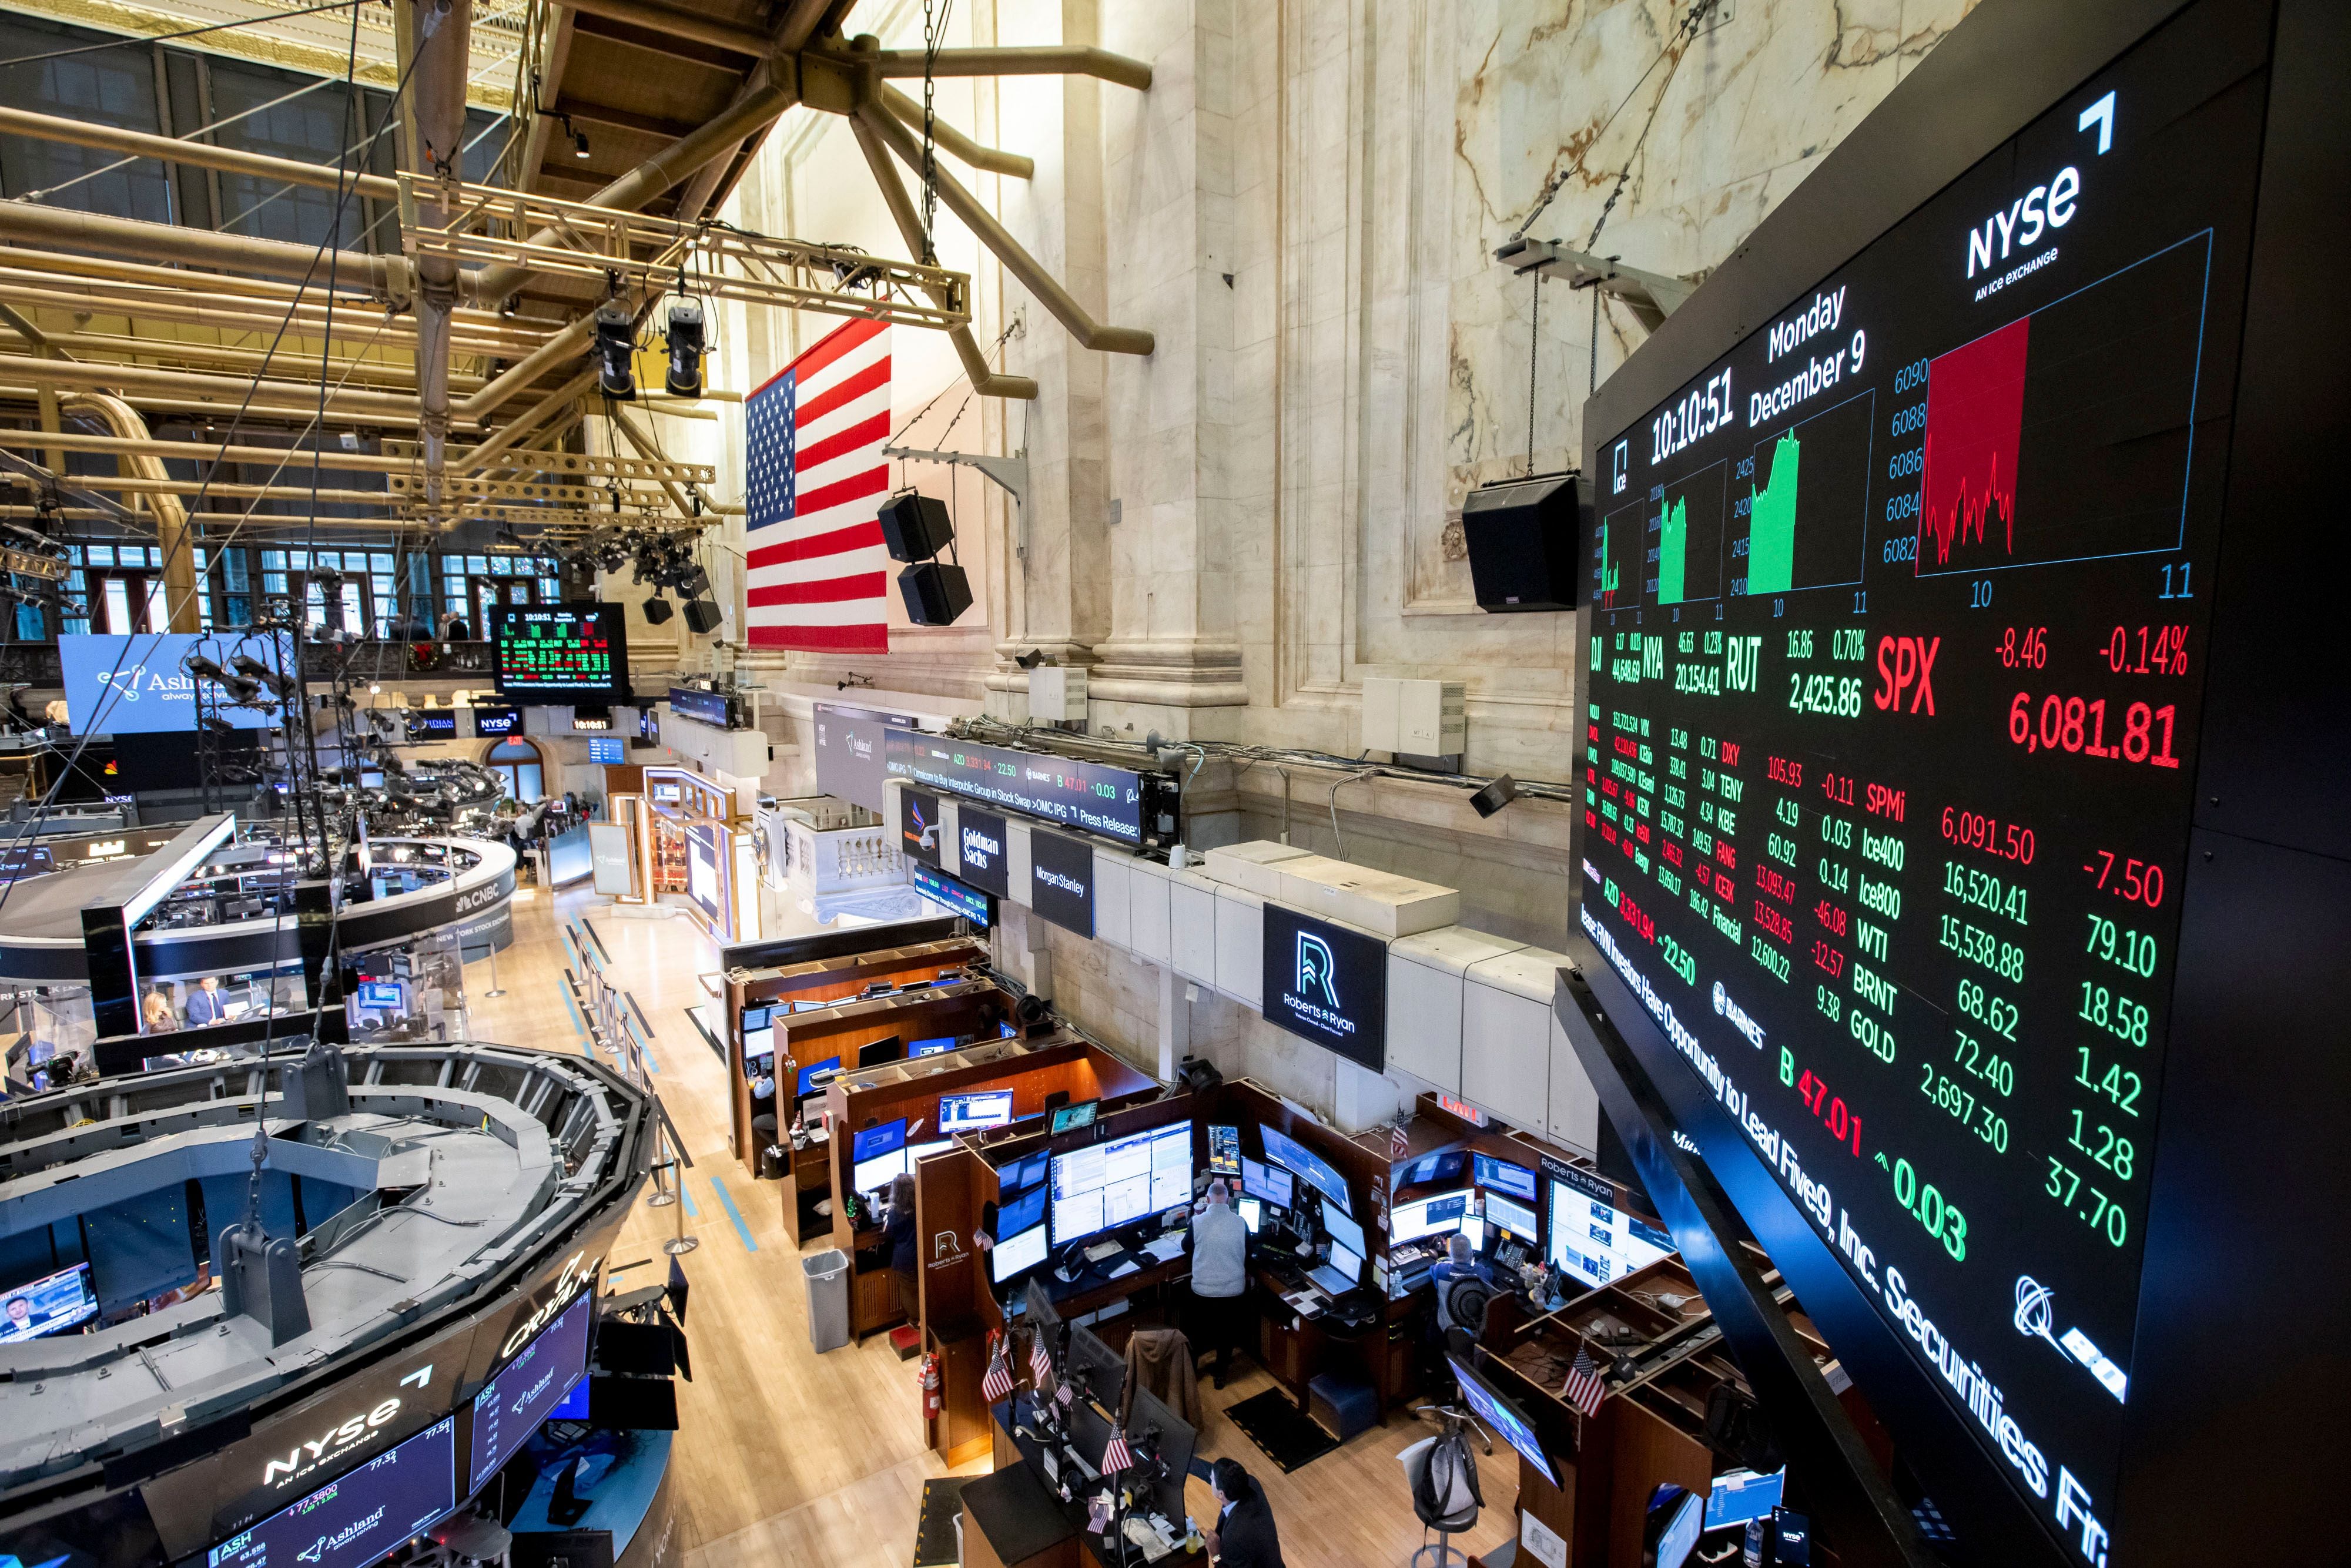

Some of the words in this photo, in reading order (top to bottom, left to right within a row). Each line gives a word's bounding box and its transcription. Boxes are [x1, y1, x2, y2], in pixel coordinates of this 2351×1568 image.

[1975, 289, 1988, 302] AN
[1769, 286, 1846, 363] Monday
[1750, 347, 1846, 427] December
[1851, 330, 1866, 374] 9
[1895, 357, 1928, 394] 6090
[1652, 367, 1733, 465] 10:10:51
[1892, 403, 1926, 437] 6088
[1736, 456, 1754, 480] 2425
[1889, 447, 1923, 479] 6086
[1734, 497, 1751, 518] 2420
[1887, 491, 1920, 521] 6084
[1733, 537, 1750, 557] 2415
[1884, 536, 1917, 563] 6082
[1730, 577, 1747, 596] 2410
[1971, 581, 1992, 608] 10
[2159, 562, 2193, 599] 11
[1590, 636, 1602, 672] DJI
[1616, 633, 1625, 650] 6.17
[1643, 636, 1663, 680] NYA
[1679, 632, 1694, 654] 46.63
[1704, 631, 1722, 655] 0.23%
[1787, 630, 1813, 659] 16.86
[1833, 629, 1866, 661] 0.70%
[1995, 627, 2047, 669] -8.46
[2099, 625, 2189, 675] -0.14%
[1612, 658, 1640, 684] 44,648.69
[1675, 664, 1720, 696] 20,154.41
[1726, 636, 1761, 692] RUT
[1874, 635, 1940, 716] SPX
[1789, 673, 1862, 718] 2,425.86
[574, 721, 607, 729] 10:10:51
[1640, 718, 1650, 738] VIX
[1670, 728, 1687, 750] 13.48
[1700, 736, 1716, 760] 0.71
[2009, 692, 2179, 769] 6,081.81
[853, 738, 872, 753] Ashland
[954, 753, 965, 766] AZO
[997, 762, 1016, 777] 22.50
[1032, 770, 1051, 782] BARNES
[1057, 775, 1063, 788] B
[1064, 776, 1087, 793] 47.01
[1096, 783, 1116, 799] 0.03
[1670, 756, 1686, 780] 338.41
[1702, 768, 1714, 792] 3.04
[1722, 741, 1740, 766] DXY
[1767, 756, 1802, 788] 105.93
[1821, 773, 1854, 806] -0.11
[913, 767, 934, 782] Omnicom
[934, 774, 939, 784] to
[939, 773, 948, 788] Buy
[948, 776, 974, 793] Interpublic
[974, 783, 991, 799] Group
[991, 787, 997, 798] in
[997, 789, 1014, 803] Stock
[1015, 793, 1031, 810] Swap
[1054, 803, 1067, 818] IPG
[1080, 809, 1102, 827] Press
[1103, 815, 1138, 837] Release:
[1665, 783, 1685, 809] 1,126.73
[1700, 800, 1713, 824] 4.34
[1720, 774, 1743, 803] TENY
[1776, 798, 1799, 827] 4.19
[1822, 815, 1852, 849] 0.03
[963, 827, 999, 855] Goldman
[1660, 810, 1683, 839] 15,787.32
[1692, 827, 1712, 856] 149.53
[1718, 808, 1736, 836] KBE
[1768, 833, 1796, 867] 60.92
[1819, 858, 1848, 894] 0.14
[1867, 783, 1905, 823] SPMi
[1942, 806, 2035, 865] 6,091.50
[2083, 849, 2164, 909] -7.50
[964, 845, 987, 869] Sachs
[1662, 839, 1683, 868] 2,465.32
[1696, 862, 1710, 886] -4.57
[471, 883, 499, 907] CNBC
[1036, 865, 1059, 886] Morgan
[1059, 874, 1084, 897] Stanley
[1635, 846, 1649, 875] Energy
[1658, 865, 1682, 896] 13,850.17
[1689, 889, 1709, 919] 186.42
[1716, 840, 1736, 870] FANG
[1756, 864, 1796, 905] 13,093.47
[1814, 900, 1846, 936] -46.08
[1862, 828, 1904, 872] Ice400
[1943, 861, 2028, 926] 16,520.41
[2087, 913, 2156, 979] 79.10
[436, 932, 454, 943] NEW
[474, 921, 493, 933] STOCK
[1715, 872, 1734, 904] ICE3K
[1754, 900, 1793, 944] 13,528.85
[1811, 941, 1844, 979] -12.57
[1713, 904, 1742, 945] Financial
[1751, 935, 1790, 984] 12,600.22
[1817, 985, 1840, 1023] 9.38
[1858, 873, 1901, 920] Ice800
[1939, 914, 2024, 984] 15,538.88
[2078, 981, 2149, 1047] 18.58
[1284, 993, 1321, 1018] Roberts
[1330, 1012, 1355, 1033] Ryan
[1307, 1017, 1318, 1026] Owned
[1857, 917, 1888, 963] WTI
[1958, 979, 2019, 1043] 68.62
[2075, 1047, 2142, 1117] 1.42
[1604, 877, 1619, 907] AZO
[1619, 891, 1655, 946] 3,331.94
[1664, 934, 1695, 986] 22.50
[1726, 996, 1763, 1050] BARNES
[1780, 1045, 1794, 1087] B
[1798, 1069, 1861, 1158] 47.01
[1894, 1158, 1967, 1262] 0.03
[1853, 963, 1898, 1016] BRNT
[1954, 1030, 2013, 1097] 72.40
[2068, 1109, 2134, 1181] 1.28
[1850, 1010, 1896, 1064] GOLD
[1920, 1063, 2009, 1154] 2,697.30
[2045, 1155, 2126, 1248] 37.70
[1542, 1157, 1579, 1181] Roberts
[1588, 1179, 1613, 1198] Ryan
[1610, 938, 1642, 995] Investors
[1642, 974, 1663, 1021] Have
[1664, 1003, 1726, 1102] Opportunity
[1726, 1076, 1740, 1115] to
[1741, 1092, 1780, 1167] Lead
[1780, 1139, 1836, 1244] Five9,
[1840, 1208, 1880, 1294] Inc.
[1884, 1265, 2049, 1499] Securities
[928, 1258, 950, 1269] Roberts
[955, 1252, 969, 1260] Ryan
[480, 1383, 495, 1402] ASH
[525, 1368, 553, 1403] Ashland
[426, 1420, 451, 1440] 77.54
[276, 1476, 293, 1489] AN
[297, 1484, 339, 1513] 77.3800
[221, 1532, 252, 1557] ASH
[325, 1509, 383, 1550] Ashland
[333, 1533, 356, 1550] always
[356, 1520, 379, 1542] solving
[240, 1542, 266, 1562] 63,556
